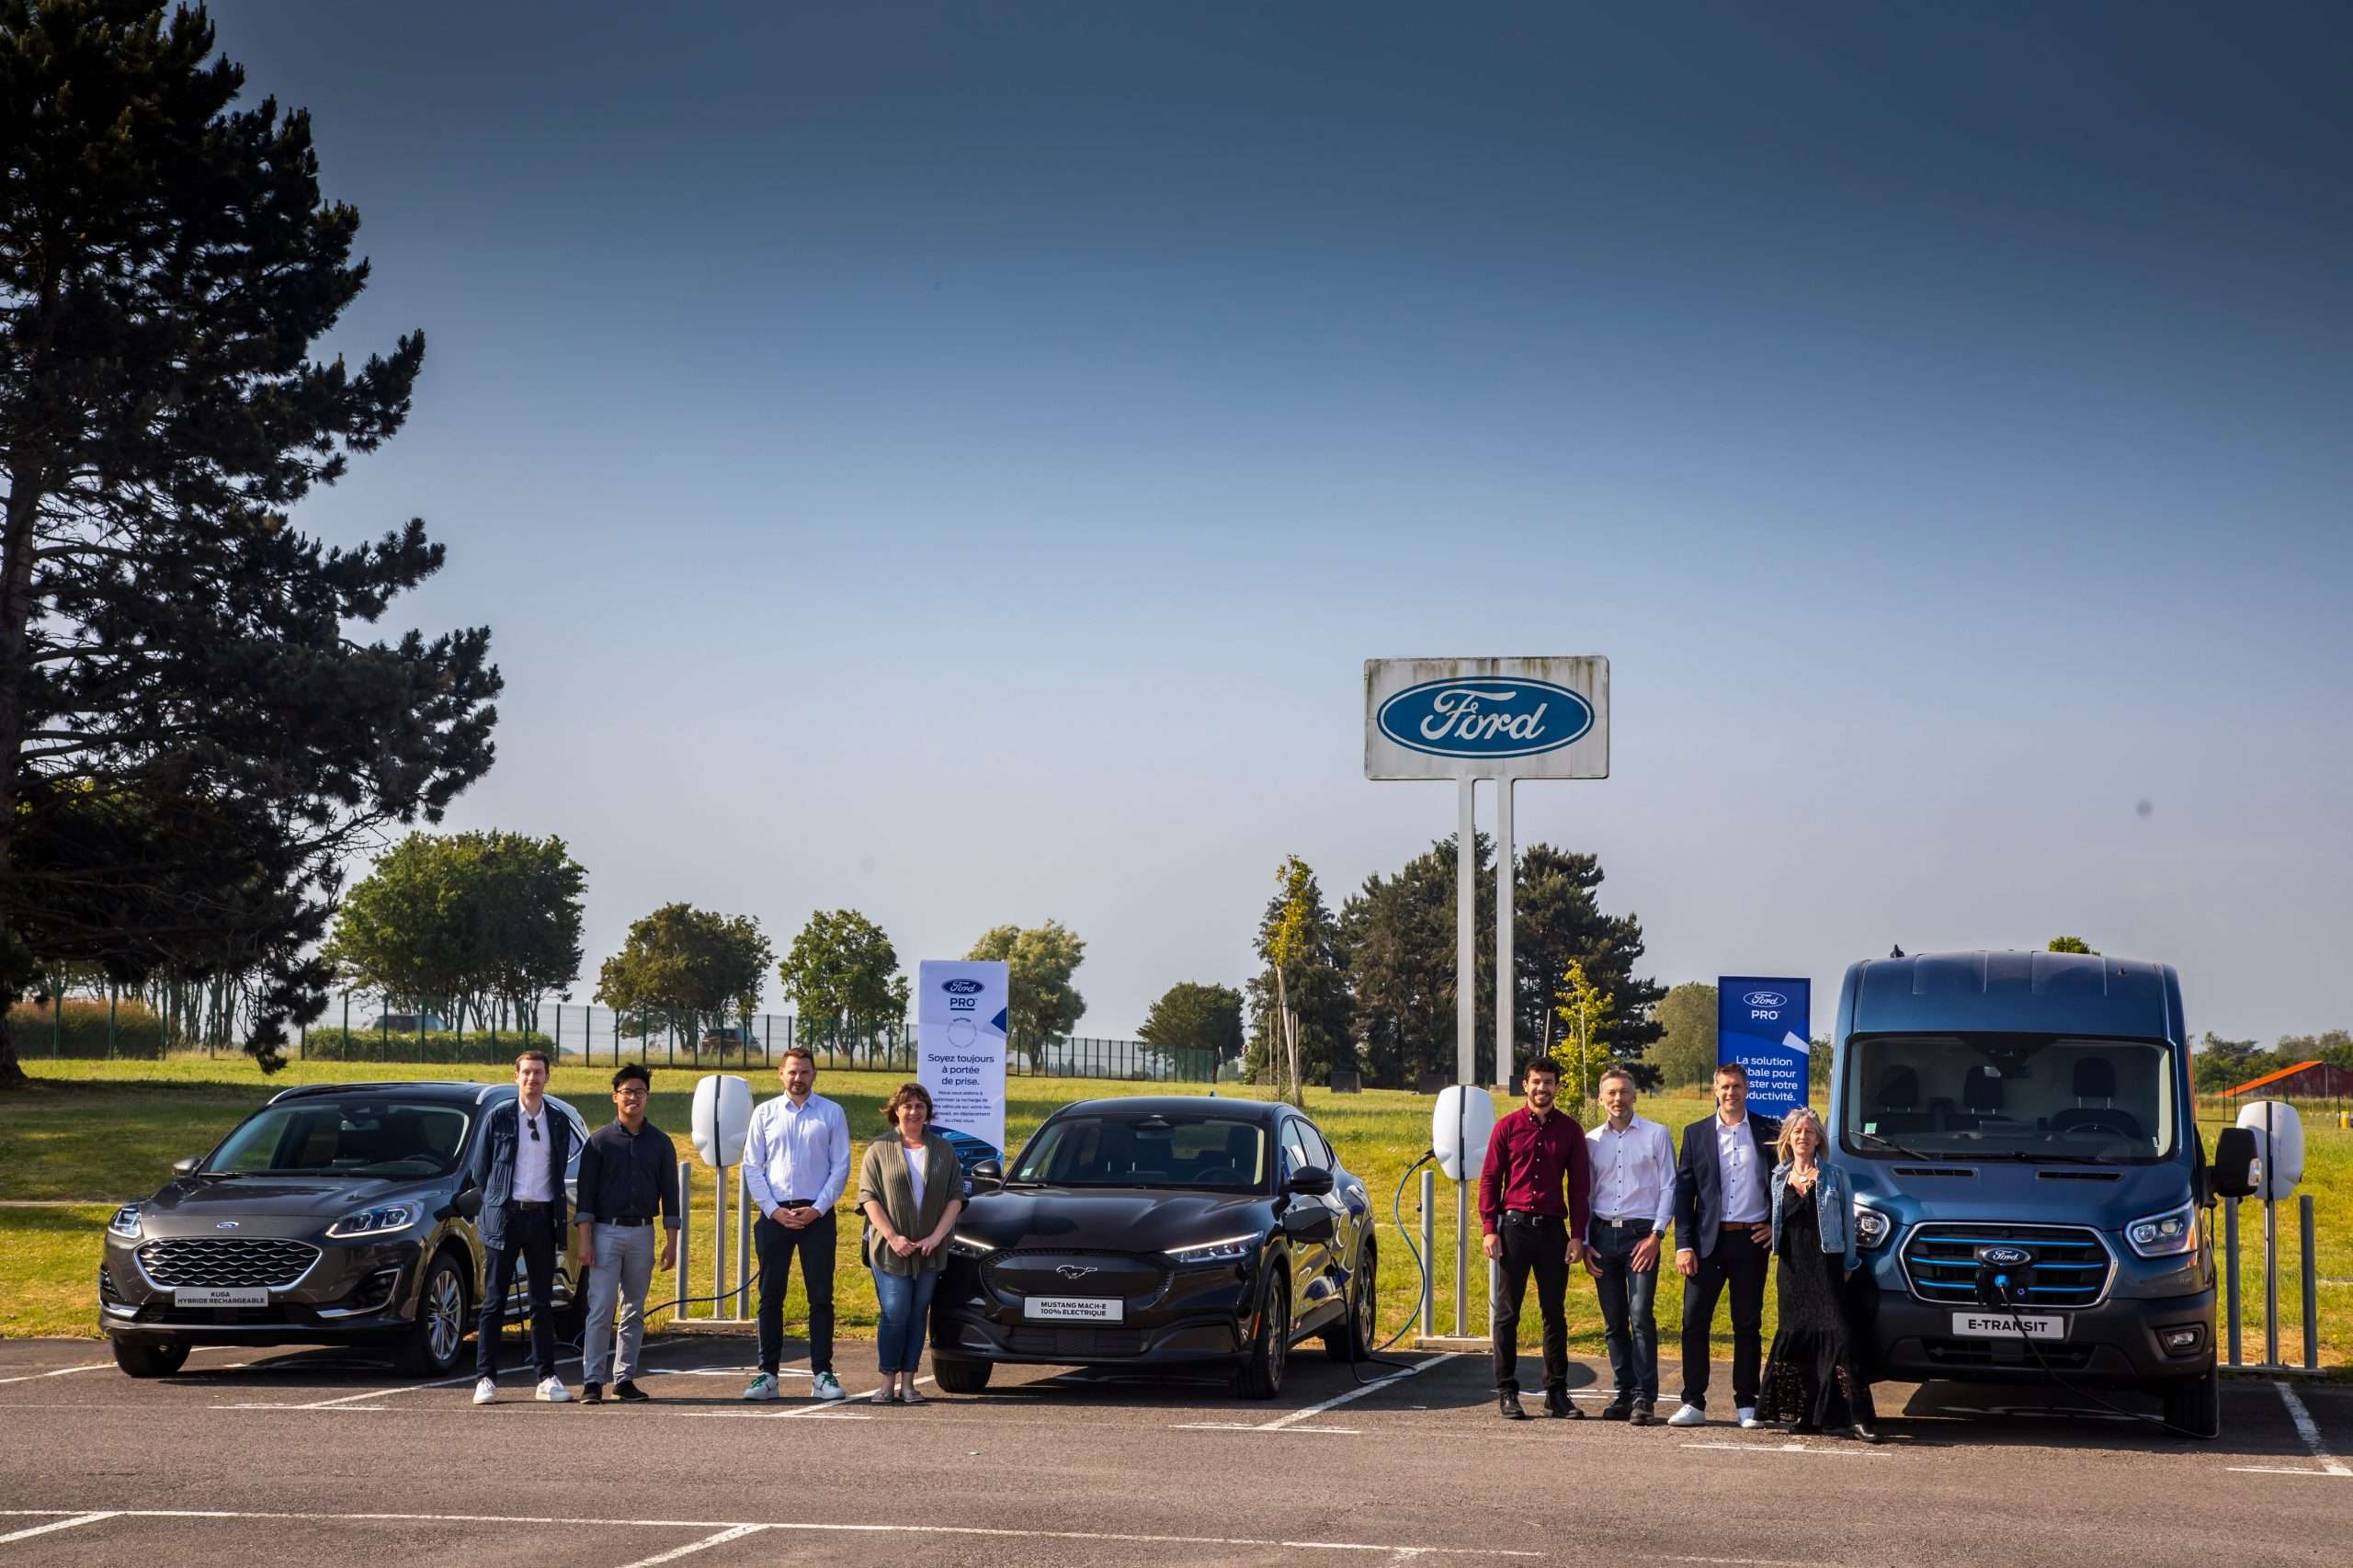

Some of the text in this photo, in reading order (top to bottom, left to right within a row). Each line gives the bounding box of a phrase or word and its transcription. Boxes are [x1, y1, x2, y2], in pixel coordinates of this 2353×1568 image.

[1420, 688, 1548, 741] Ford
[949, 981, 976, 993] Ford
[949, 997, 975, 1007] PRO
[1751, 993, 1779, 1005] Ford
[1751, 1009, 1779, 1020] PRO
[927, 1053, 995, 1064] Soyez toujours
[1735, 1054, 1793, 1066] La solution
[941, 1064, 980, 1075] à portée
[1745, 1067, 1797, 1079] bale pour
[941, 1076, 980, 1086] de prise.
[1749, 1079, 1799, 1090] ster votre
[1993, 1249, 2019, 1261] Ford
[1040, 1301, 1107, 1310] MUSTANG MACH-E
[1040, 1308, 1107, 1317] 100% ELECTRIQUE
[1967, 1318, 2049, 1333] E-TRANSIT
